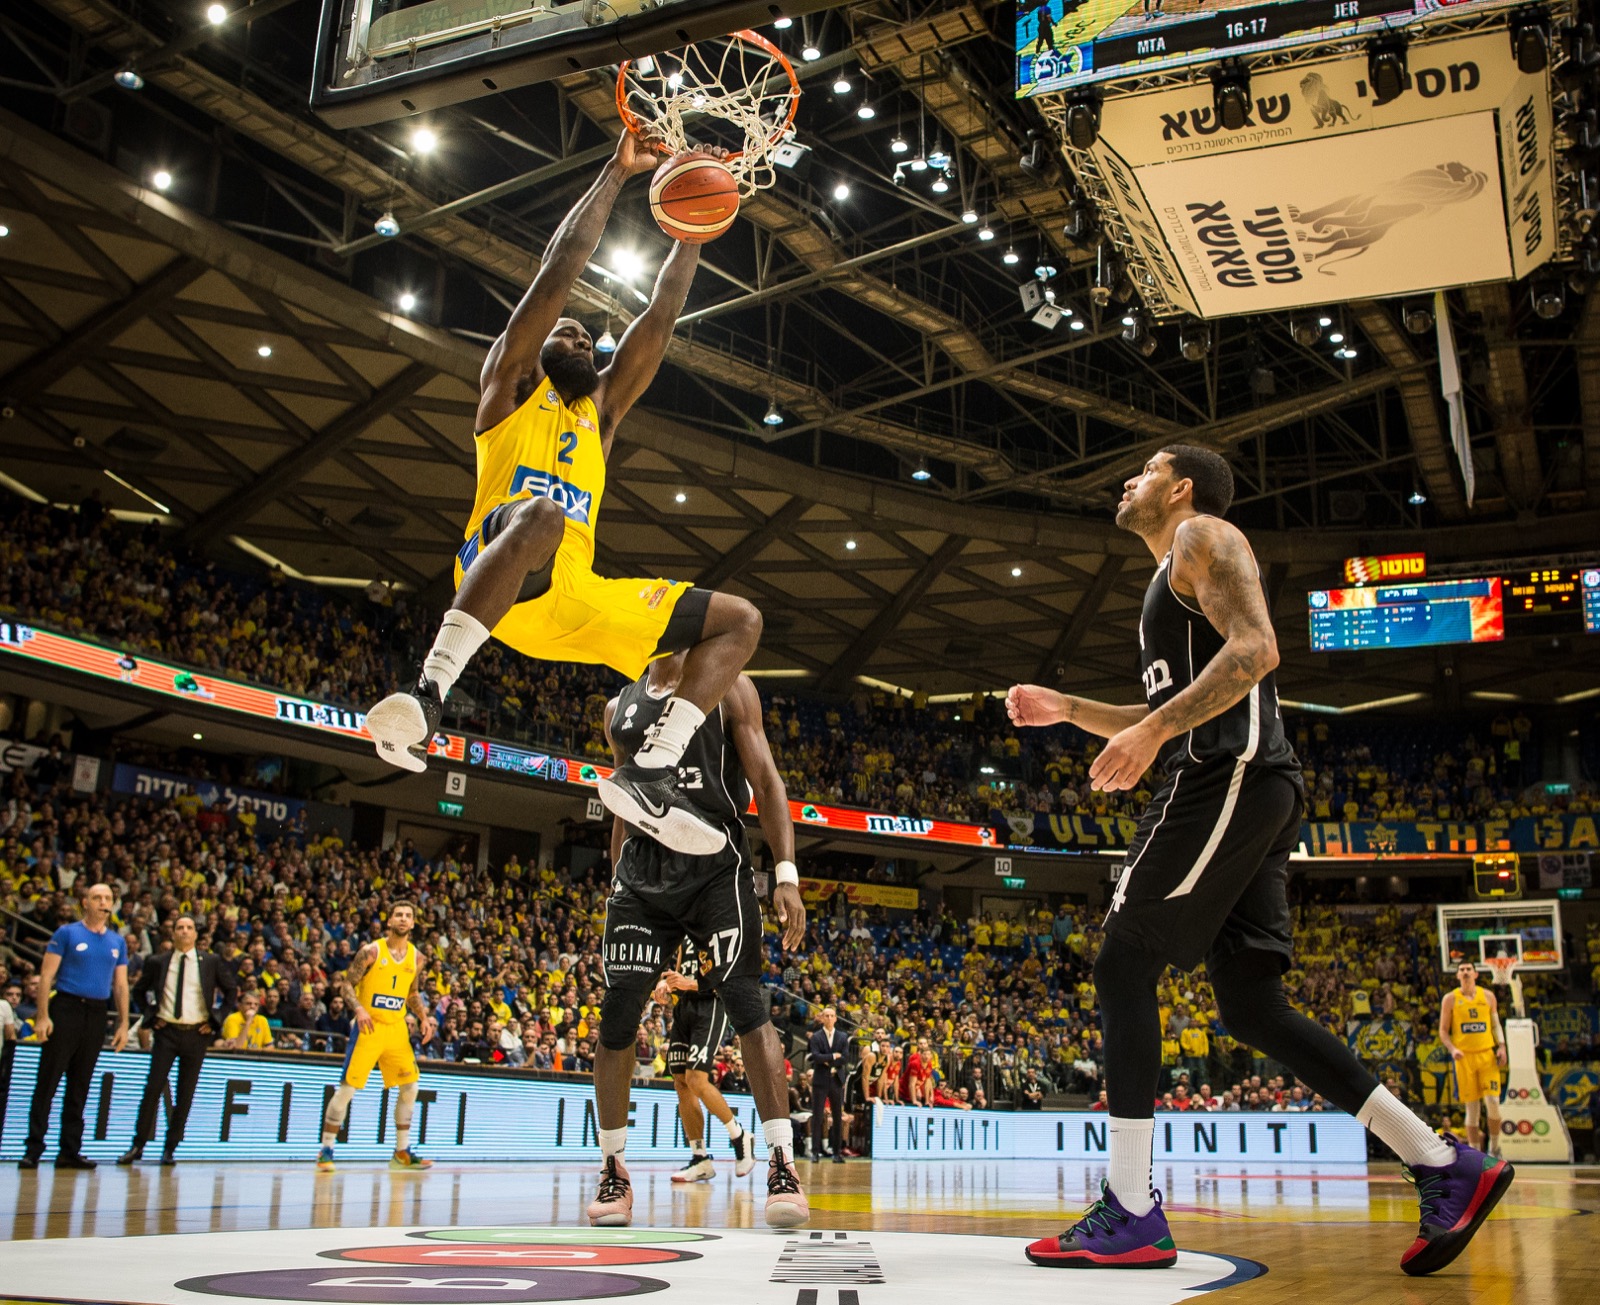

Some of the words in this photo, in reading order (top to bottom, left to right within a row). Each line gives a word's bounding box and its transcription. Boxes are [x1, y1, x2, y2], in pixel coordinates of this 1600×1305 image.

[1333, 1, 1359, 19] JER
[1137, 37, 1166, 55] MTA
[1159, 92, 1291, 141] ששא
[1203, 133, 1247, 150] הראשונה
[1249, 126, 1293, 142] המחלקה
[1166, 142, 1202, 155] בדרכים
[1185, 200, 1258, 288] שאשא
[1243, 206, 1303, 284] מסיעי
[558, 432, 578, 466] 2
[520, 476, 590, 517] FOX
[1381, 558, 1424, 576] טוטו
[470, 742, 485, 765] 9
[550, 759, 569, 782] 10
[452, 777, 460, 791] 9
[589, 803, 602, 817] 10
[1416, 820, 1511, 852] THE
[996, 862, 1010, 873] 10
[604, 943, 661, 965] LUCIANA
[708, 927, 740, 967] 17
[392, 975, 398, 990] 1
[374, 996, 405, 1010] FOX
[1462, 1023, 1486, 1033] FOX
[688, 1044, 708, 1064] 24
[894, 1115, 1000, 1150] INFINITI
[1056, 1121, 1317, 1154] ININITI
